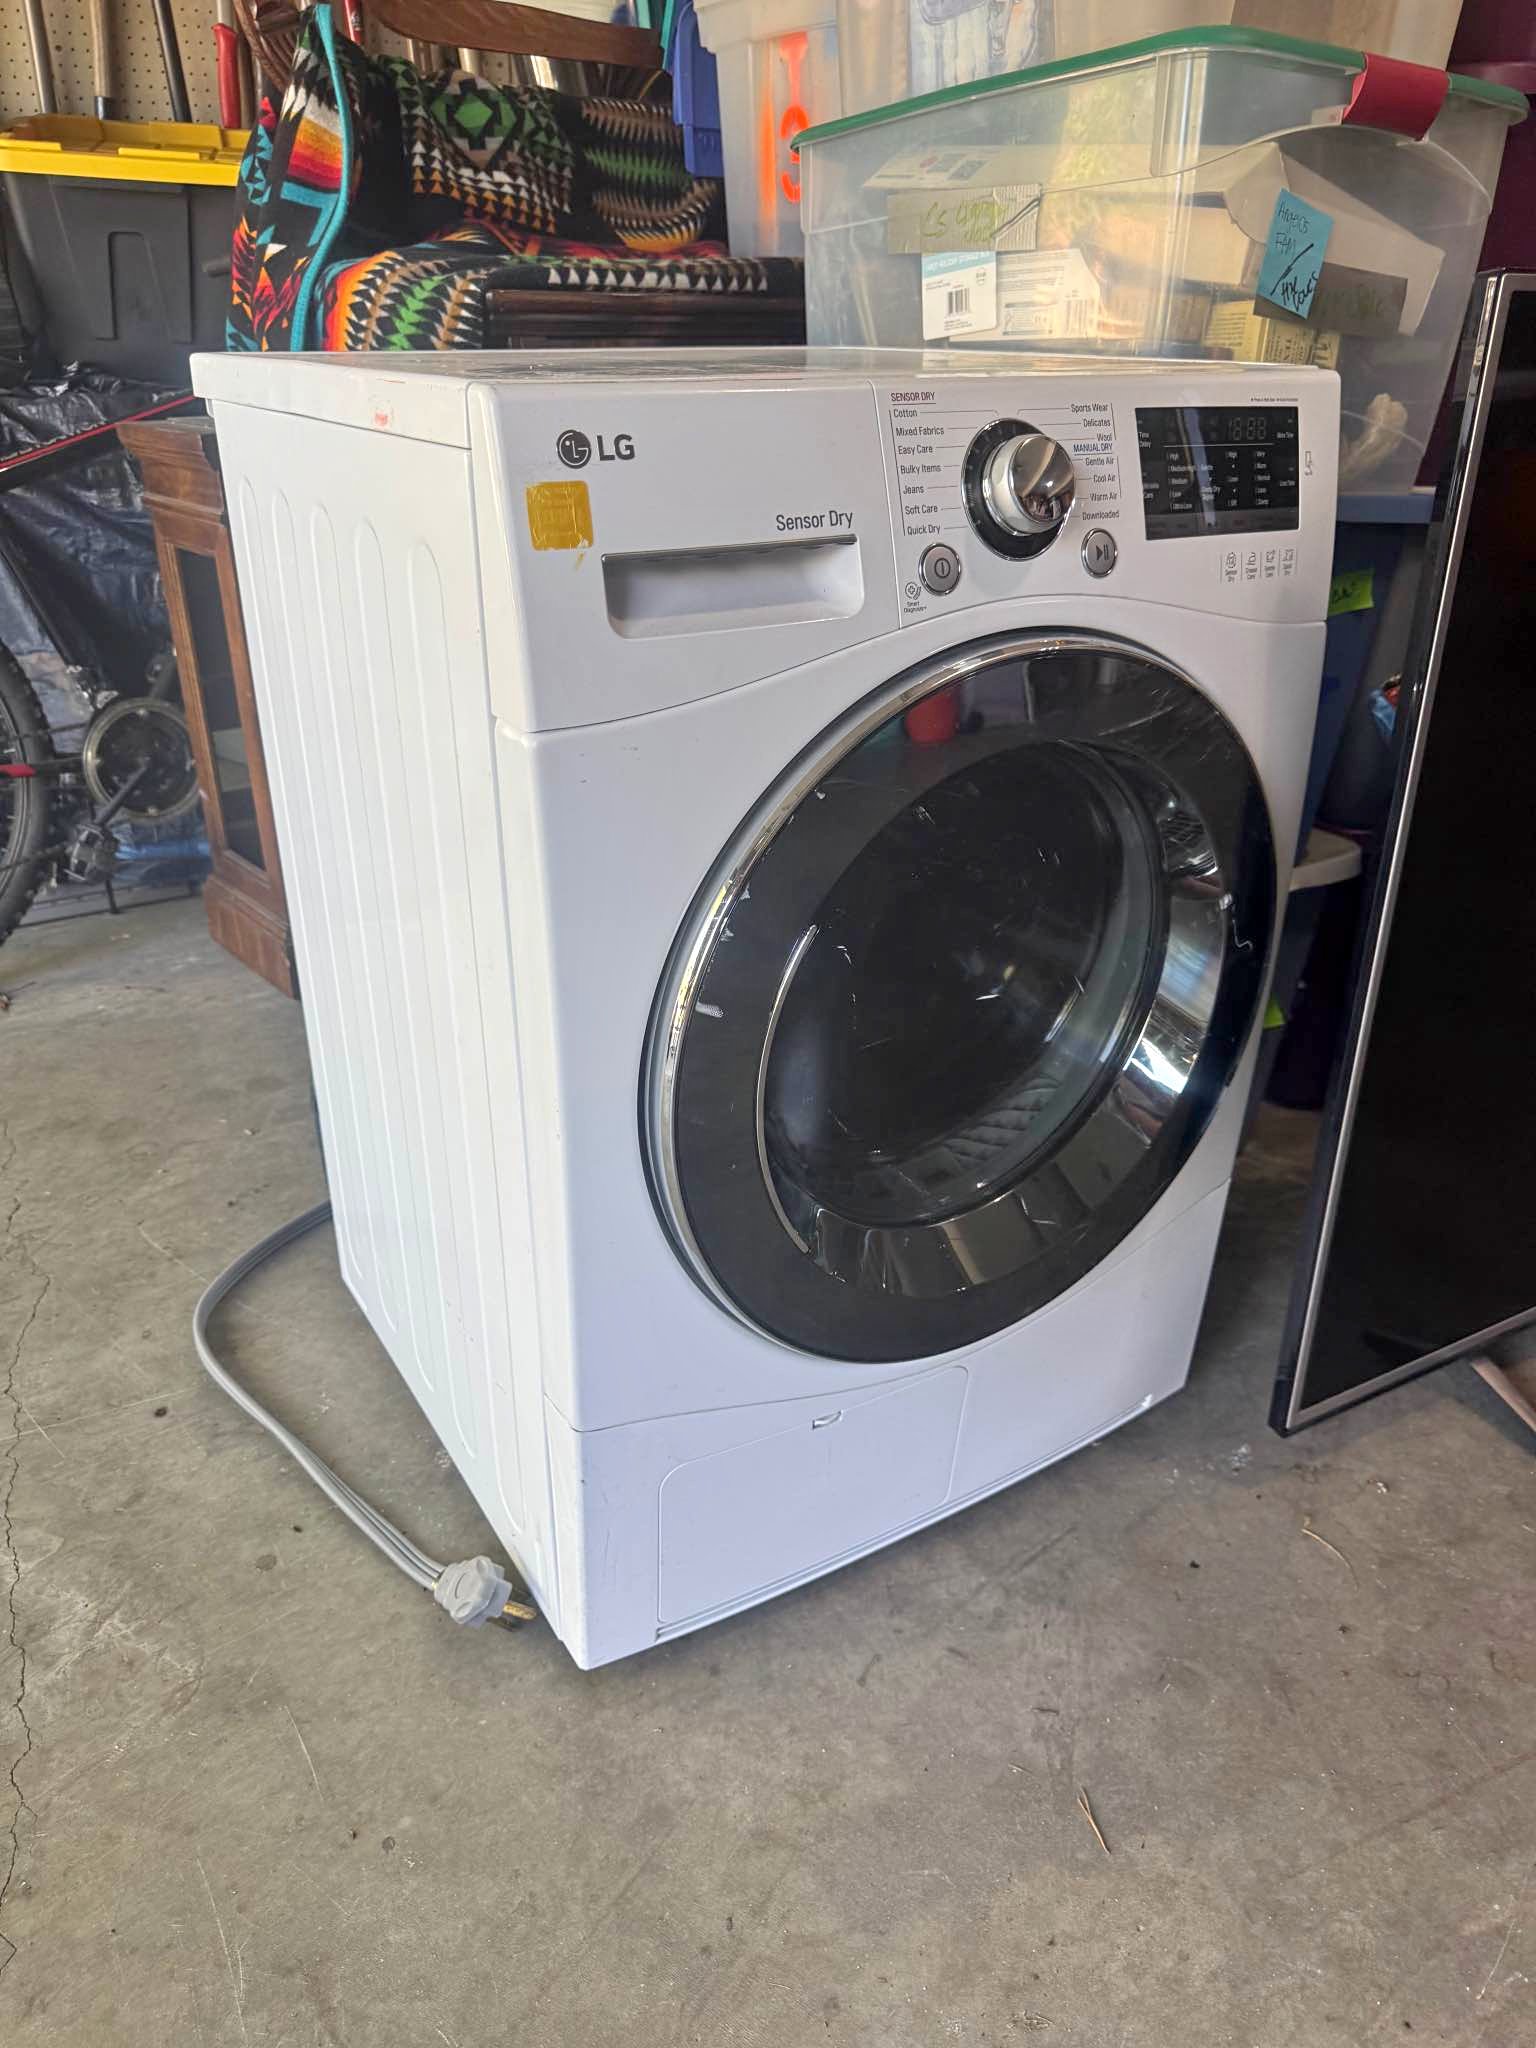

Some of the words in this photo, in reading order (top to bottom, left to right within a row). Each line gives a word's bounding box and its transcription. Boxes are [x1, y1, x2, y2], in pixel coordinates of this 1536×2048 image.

[890, 392, 920, 402] SENSOR
[921, 391, 936, 401] DRY
[893, 408, 918, 418] Cotton
[1071, 403, 1091, 413] Sports
[1092, 402, 1108, 412] Wear
[1083, 418, 1111, 428] Delicates
[896, 426, 917, 436] Mixed
[918, 425, 945, 436] Fabrics
[1096, 433, 1112, 442] Wool
[596, 434, 635, 462] LG
[898, 445, 915, 455] Easy
[916, 444, 933, 454] Care
[1073, 443, 1100, 453] MANUAL
[1100, 443, 1113, 452] DRY
[1085, 457, 1105, 466] Gentle
[1106, 457, 1114, 465] Air
[900, 464, 920, 475] Bulky
[921, 463, 942, 473] Items
[1093, 474, 1106, 483] Cool
[1107, 474, 1116, 482] Air
[903, 484, 924, 495] Jeans
[1090, 493, 1109, 501] Warm
[1109, 492, 1118, 500] Air
[905, 505, 920, 515] Soft
[921, 504, 938, 514] Care
[1082, 510, 1120, 520] Downloaded
[776, 512, 826, 532] Sensor
[829, 509, 853, 529] Dry
[907, 525, 927, 536] Quick
[928, 524, 941, 535] Dry
